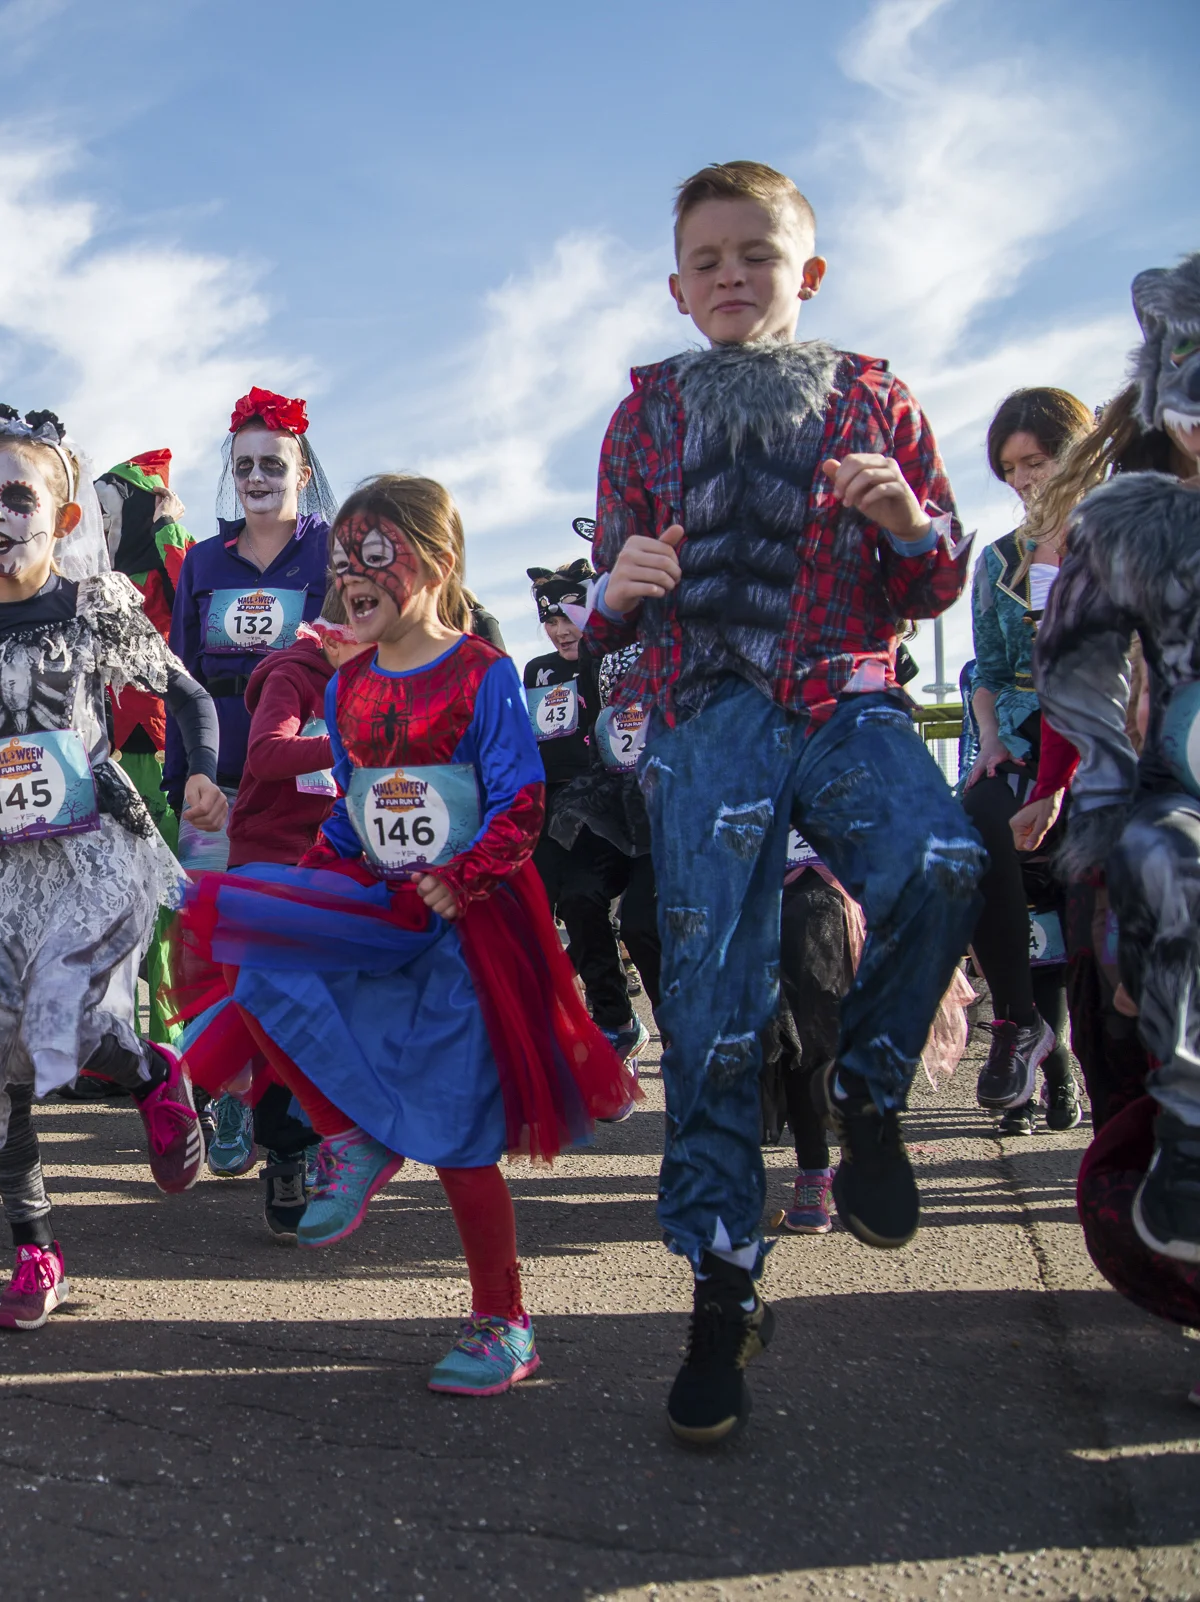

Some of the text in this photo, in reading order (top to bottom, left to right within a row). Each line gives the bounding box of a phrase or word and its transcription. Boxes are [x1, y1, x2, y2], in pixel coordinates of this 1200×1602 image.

[233, 615, 273, 635] 132
[545, 706, 566, 723] 43
[1, 764, 30, 774] FUN RUN
[372, 781, 429, 797] HALLOWEEN
[373, 816, 435, 846] 146
